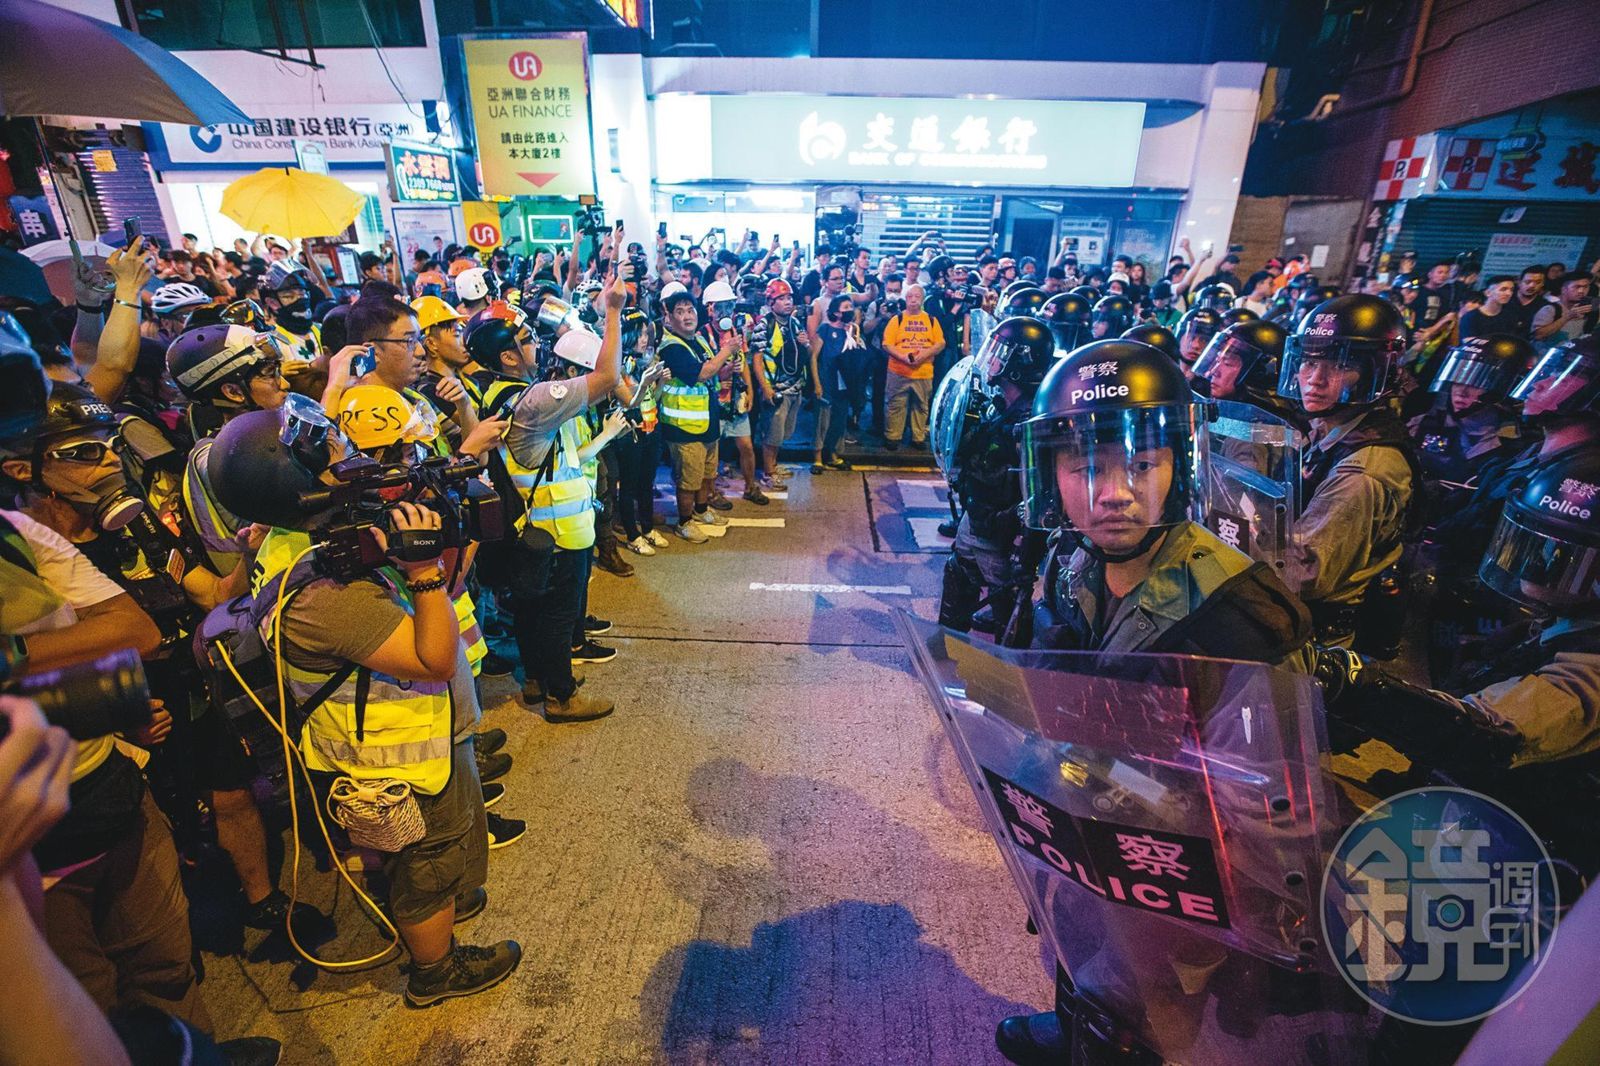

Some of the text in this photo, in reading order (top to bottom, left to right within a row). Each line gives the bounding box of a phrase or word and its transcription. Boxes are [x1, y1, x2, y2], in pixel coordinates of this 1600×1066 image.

[514, 56, 537, 77] UA
[487, 88, 570, 101] 亞洲聯合財務
[489, 104, 572, 118] UA FINANCE
[862, 111, 1036, 153] 交通銀行
[232, 139, 262, 150] China
[330, 139, 356, 150] Bank
[473, 226, 496, 244] UA
[1304, 327, 1334, 336] Police
[1078, 361, 1118, 381] 警察
[1071, 384, 1129, 405] Police
[1539, 495, 1591, 519] Police
[1010, 821, 1219, 921] POLICE
